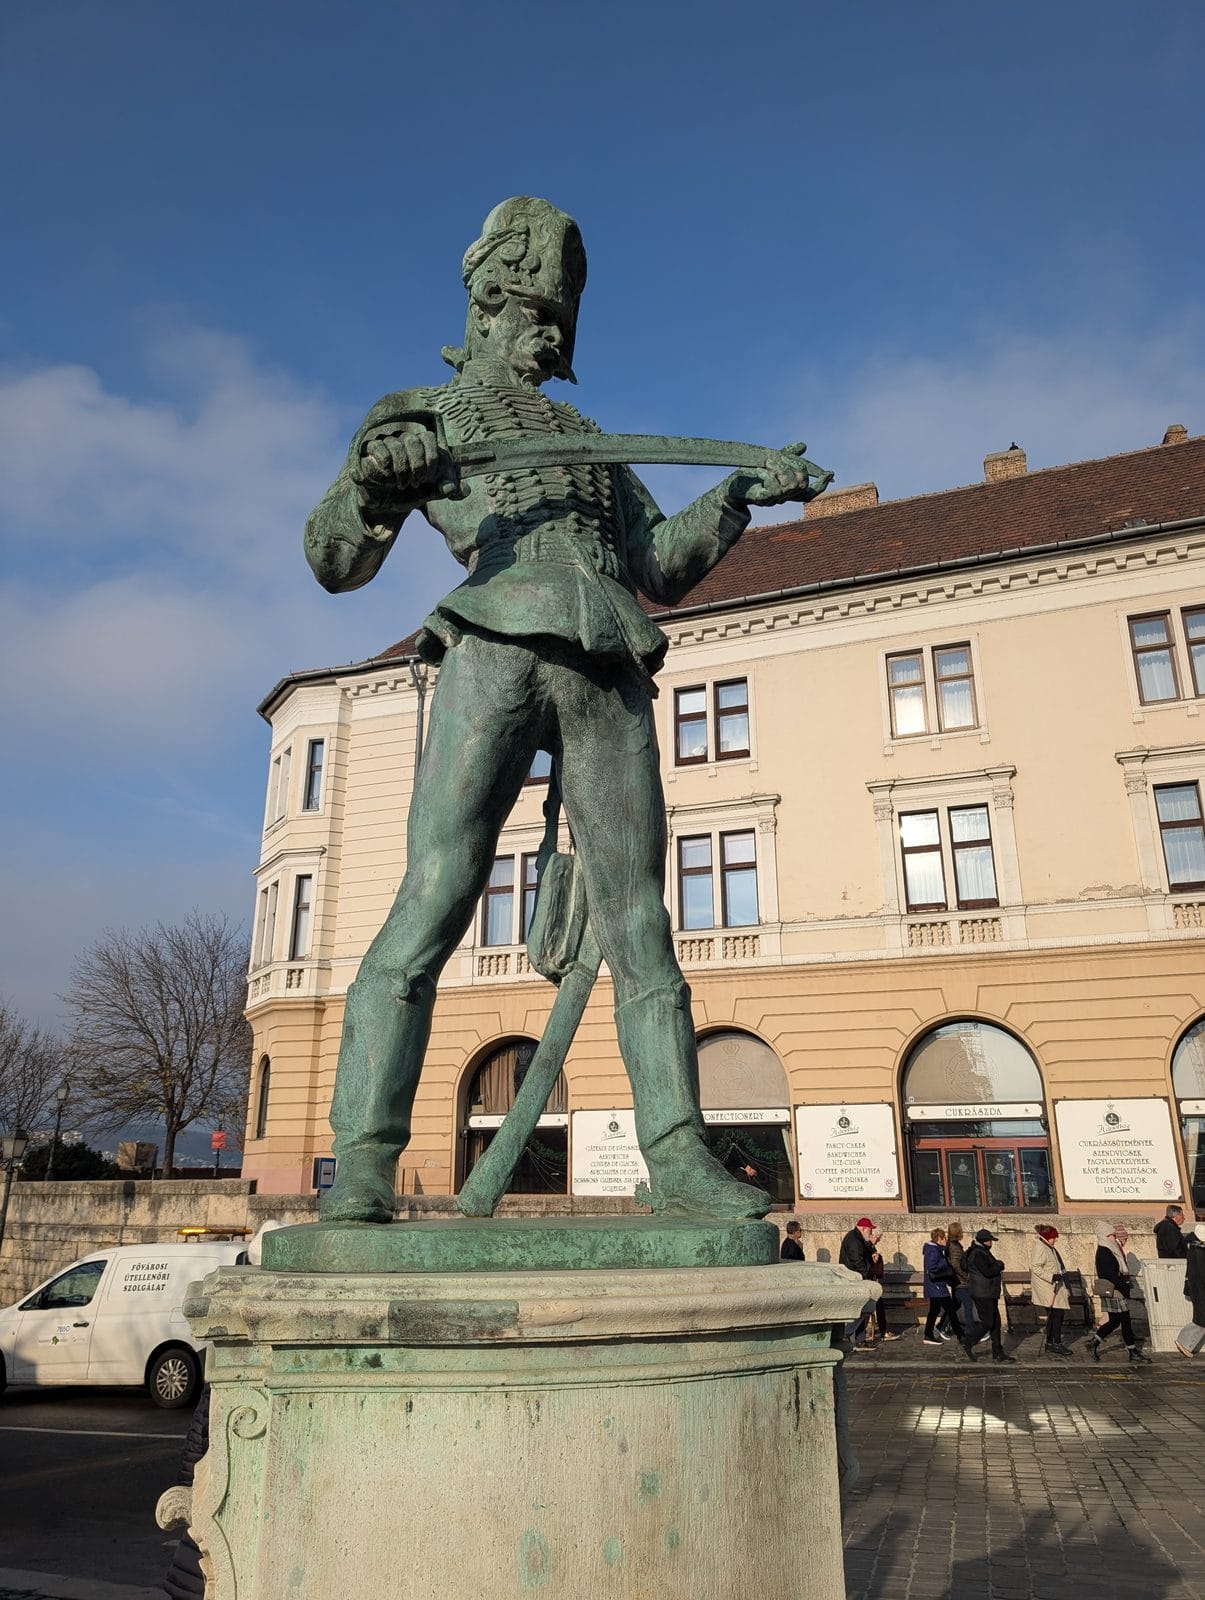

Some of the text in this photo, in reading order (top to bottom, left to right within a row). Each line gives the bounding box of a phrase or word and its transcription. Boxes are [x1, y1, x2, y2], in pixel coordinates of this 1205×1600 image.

[704, 1113, 764, 1121] ONFECTIONERY
[945, 1108, 1002, 1117] CUKRÁSZDA
[131, 1262, 168, 1271] FŐVÁROSI
[124, 1272, 170, 1281] ÚTELLENŐRI
[123, 1282, 166, 1292] SZOLGÁLAT
